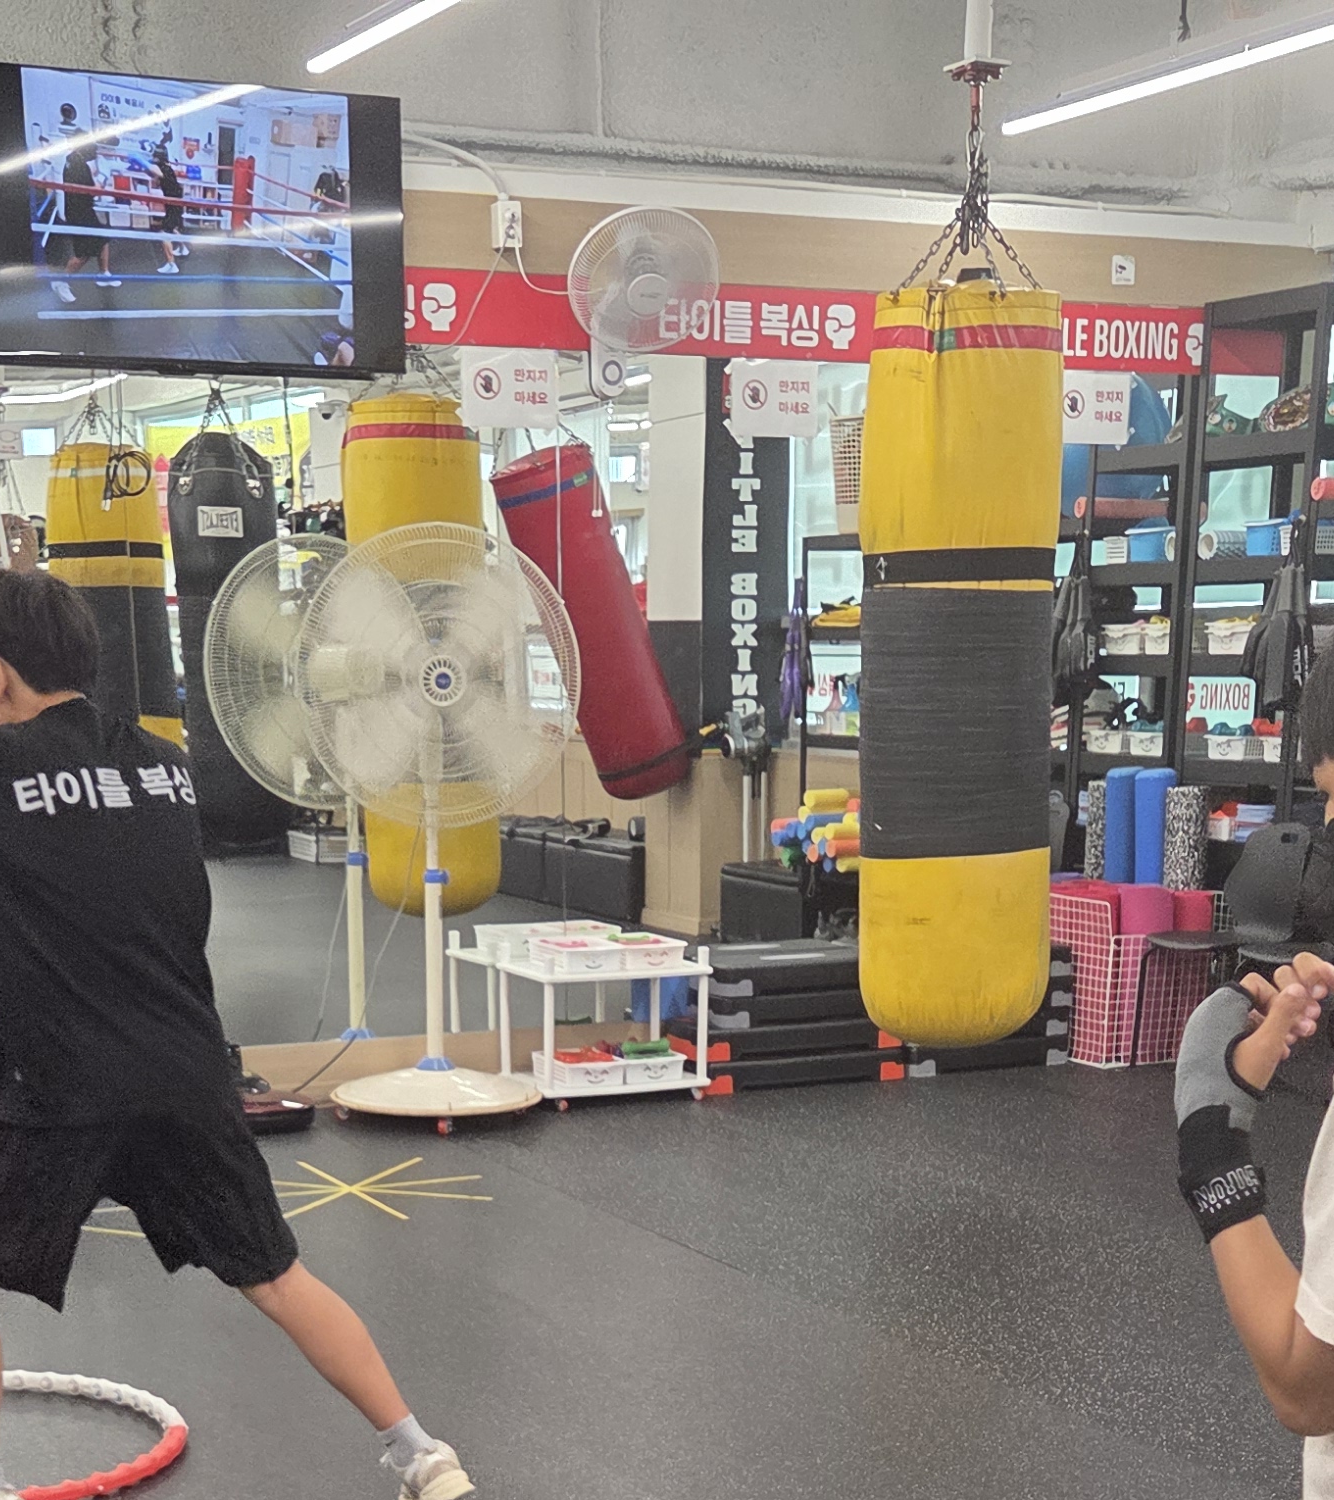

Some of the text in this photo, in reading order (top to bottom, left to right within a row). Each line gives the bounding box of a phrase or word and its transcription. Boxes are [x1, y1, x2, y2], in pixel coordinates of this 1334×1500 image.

[658, 298, 819, 347] 타이틀 복싱
[1093, 319, 1179, 361] BOXING
[514, 368, 548, 383] 만지지
[779, 380, 810, 394] 만지지
[514, 391, 548, 405] 마세요
[1095, 391, 1124, 403] 만지지
[779, 401, 810, 415] 마세요
[1094, 411, 1123, 423] 마세요
[12, 763, 197, 815] 타이틀 복싱
